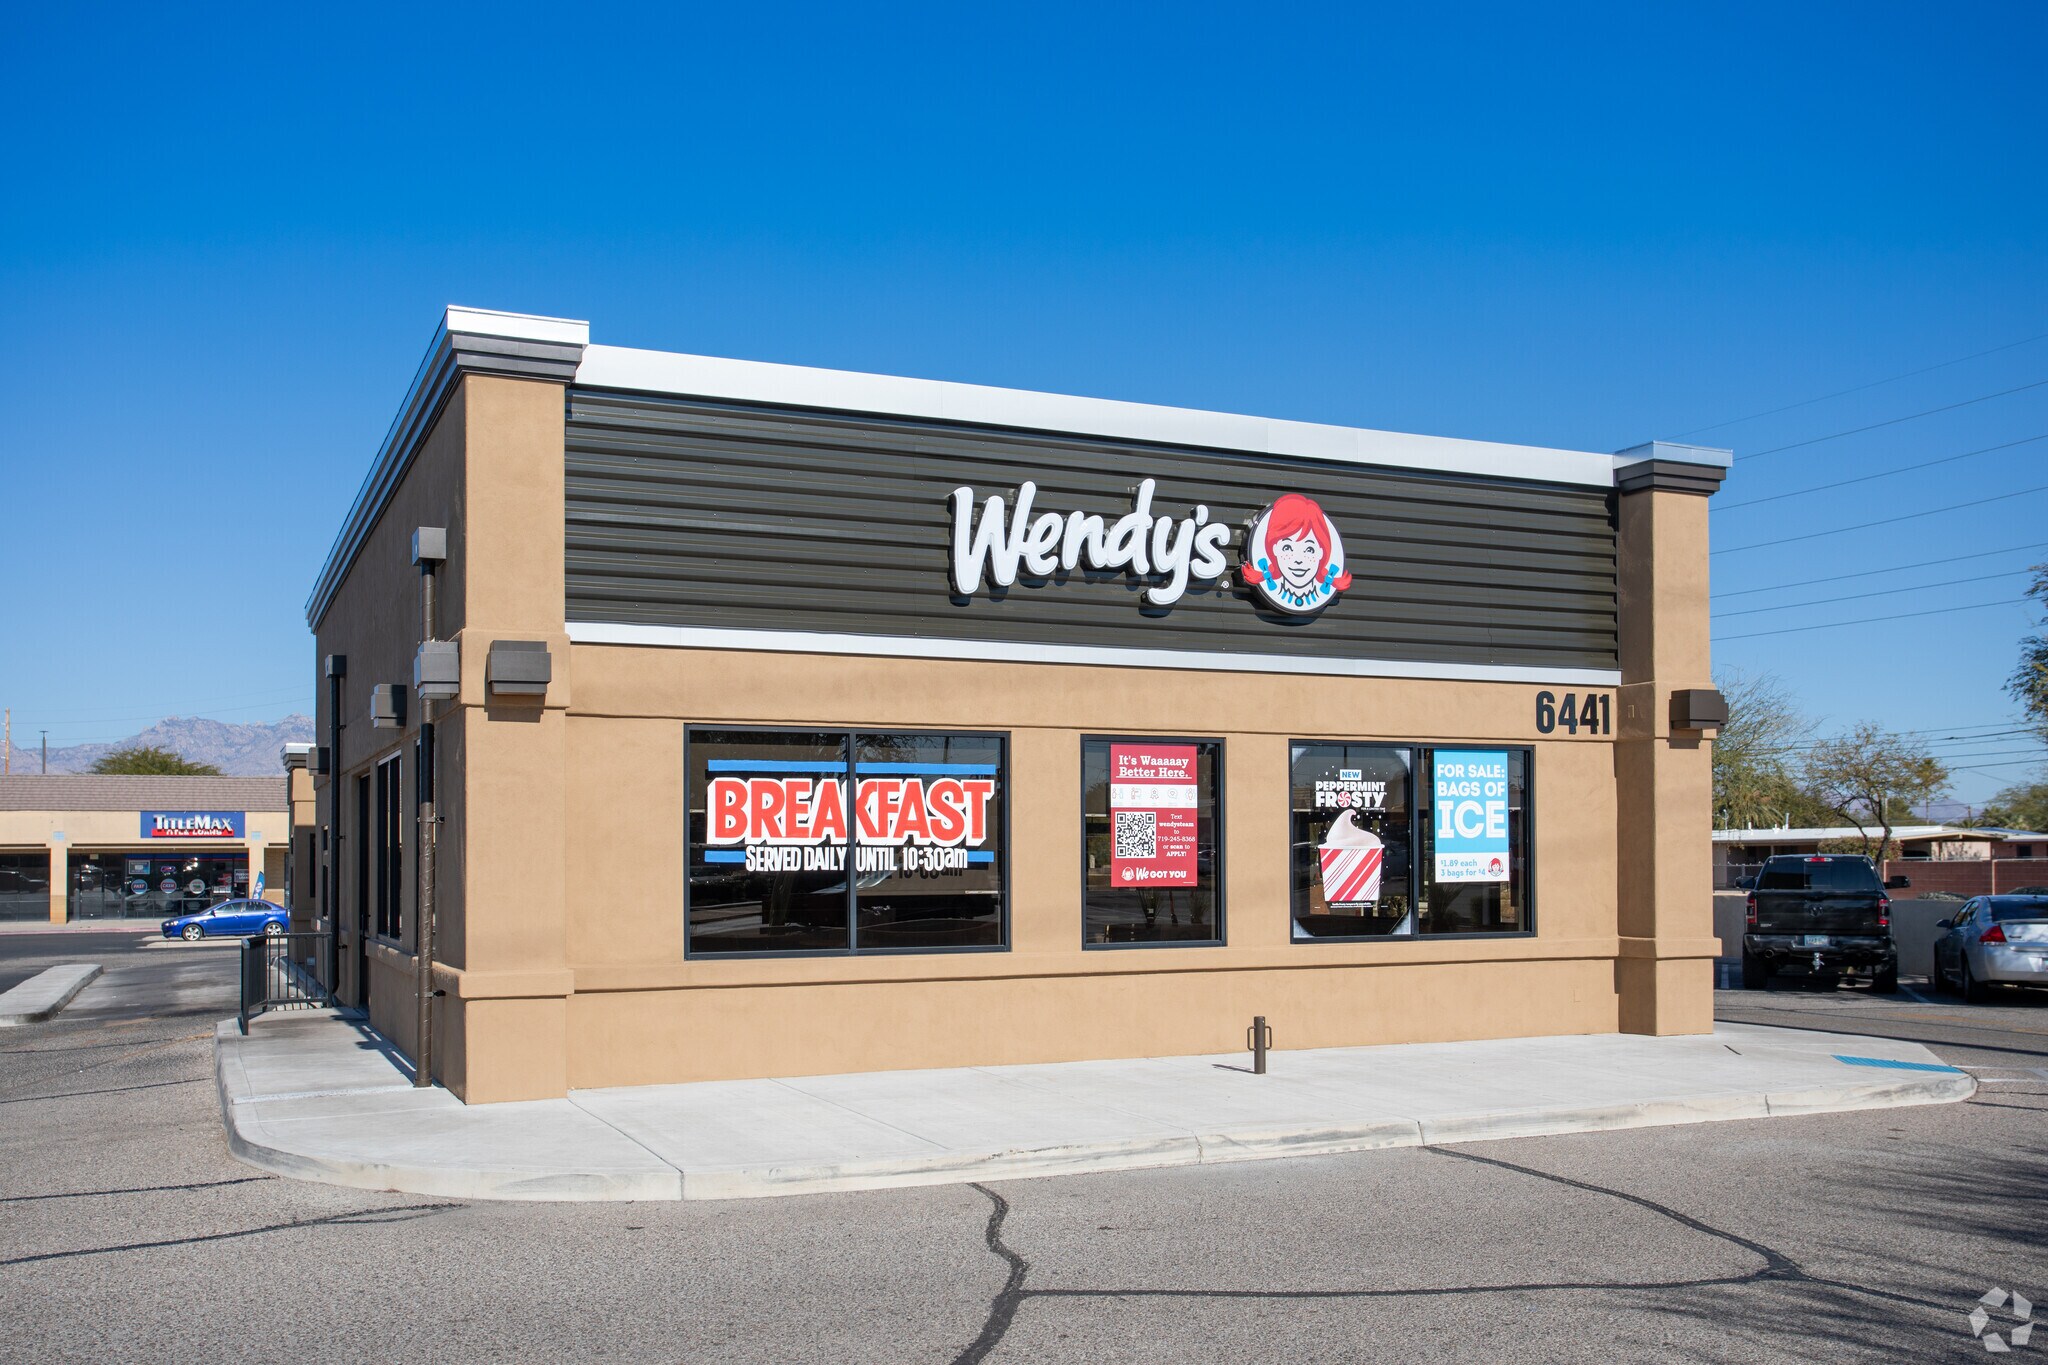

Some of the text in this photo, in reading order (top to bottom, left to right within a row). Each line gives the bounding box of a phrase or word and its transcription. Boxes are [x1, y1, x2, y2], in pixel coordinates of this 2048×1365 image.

[951, 478, 1231, 605] Wendy's
[1536, 691, 1610, 735] 6441
[1118, 755, 1189, 769] It's Waaaaay
[1119, 766, 1189, 777] Better Here.
[1341, 771, 1360, 779] NEW
[1437, 763, 1505, 778] FOR SALE:
[1315, 780, 1386, 792] PEPPERMINT
[1437, 781, 1506, 797] BAGS OF
[1315, 791, 1385, 808] FROSTY
[707, 777, 995, 847] BREAKFAST
[1438, 800, 1506, 839] ICE
[1158, 821, 1195, 829] wendysteam
[745, 845, 968, 872] SERVED DAILY UNTIL 10:30am
[1440, 859, 1478, 867] $1.89 each
[1135, 866, 1187, 881] We GOT YOU
[1440, 868, 1486, 878] 3 bags for $4
